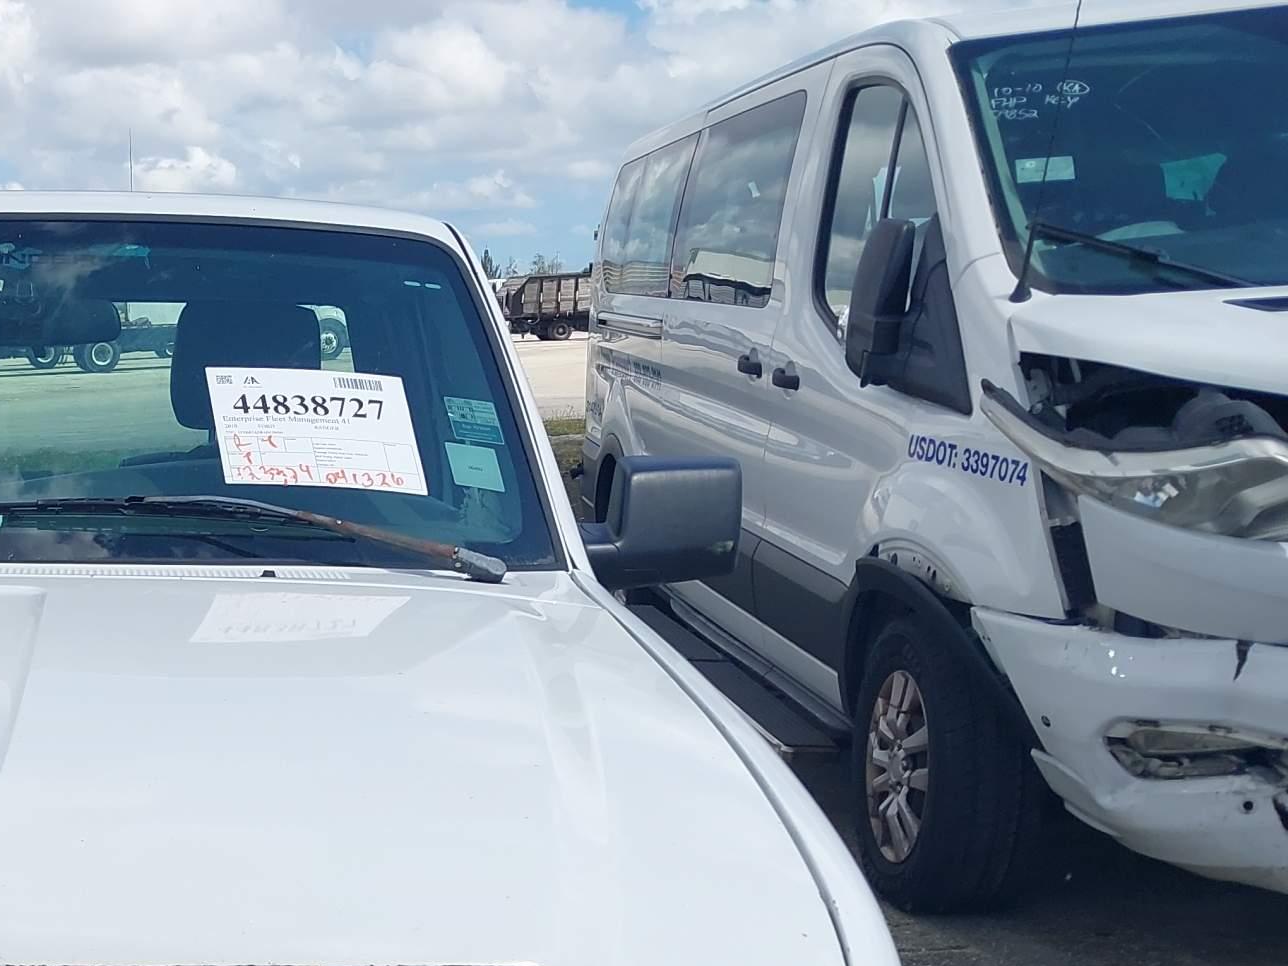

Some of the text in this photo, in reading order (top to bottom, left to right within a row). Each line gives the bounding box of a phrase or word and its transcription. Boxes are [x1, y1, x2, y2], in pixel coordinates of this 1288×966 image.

[222, 415, 264, 423] Enterprise
[288, 416, 339, 425] Management
[233, 393, 384, 420] 44838727
[907, 434, 1029, 486] USDOT: 3397074
